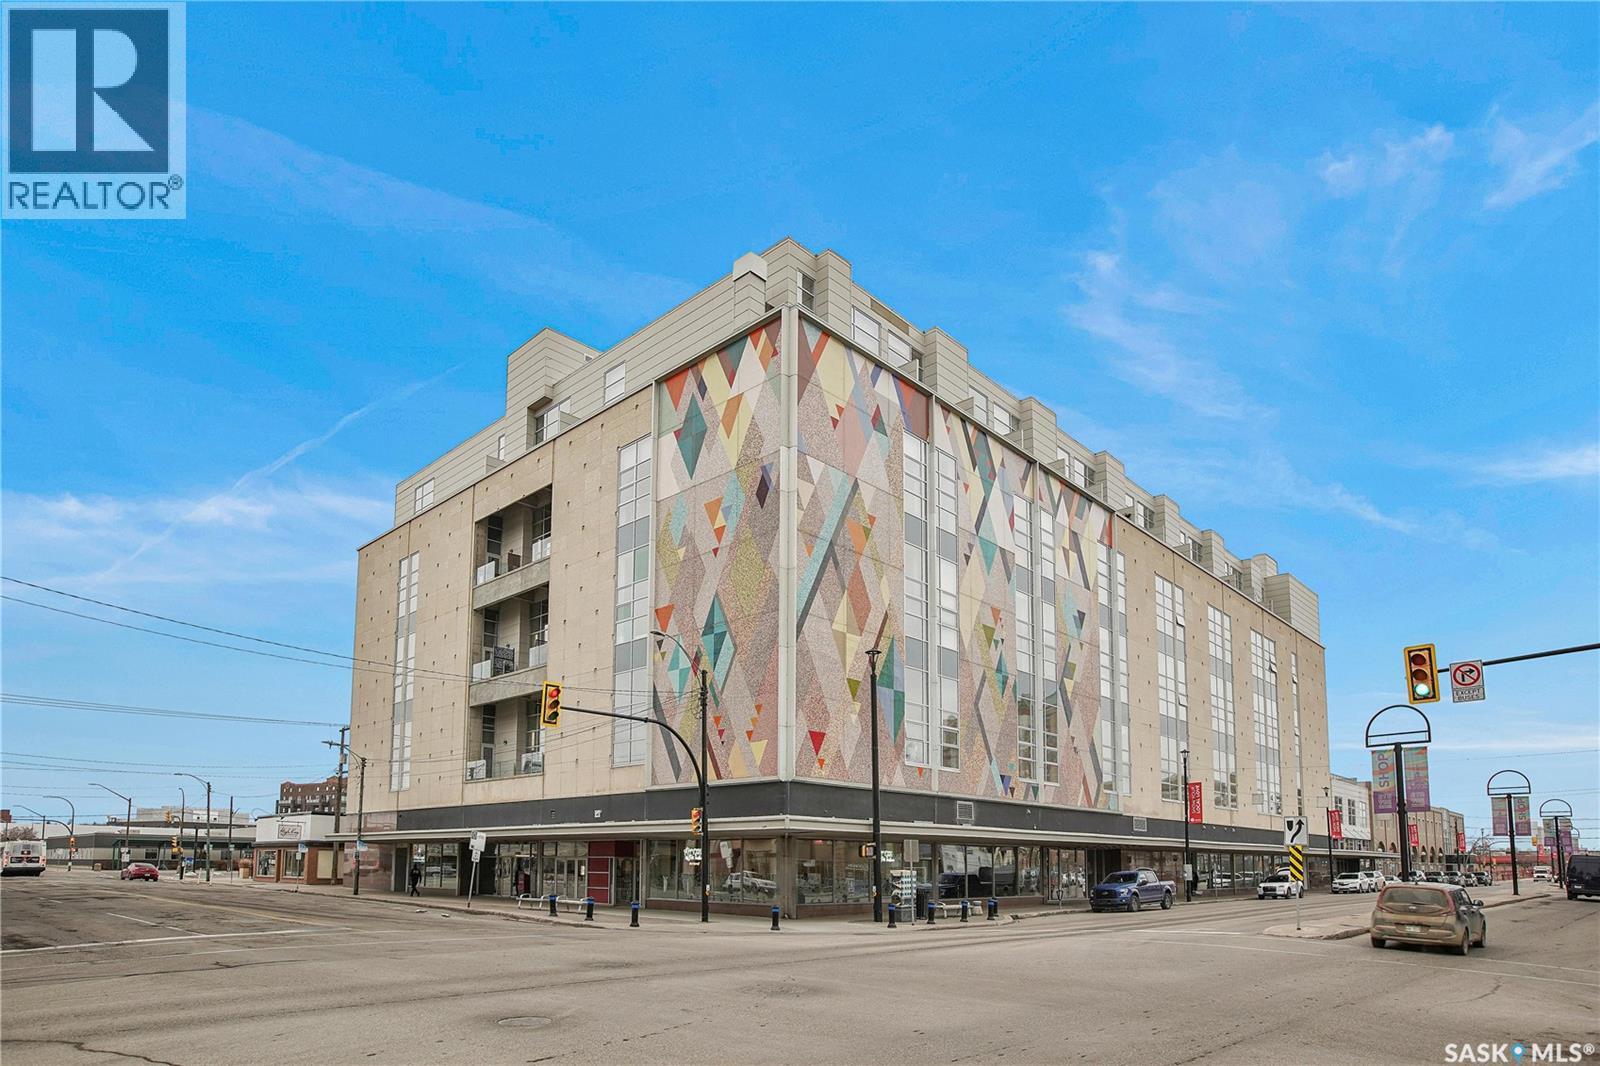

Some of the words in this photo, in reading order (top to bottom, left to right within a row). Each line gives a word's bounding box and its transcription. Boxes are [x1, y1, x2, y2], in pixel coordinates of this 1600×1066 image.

[1456, 687, 1480, 697] EXCEPT
[1457, 693, 1480, 702] BUSES
[1377, 753, 1390, 788] SHOP
[1517, 798, 1527, 821] SHOP
